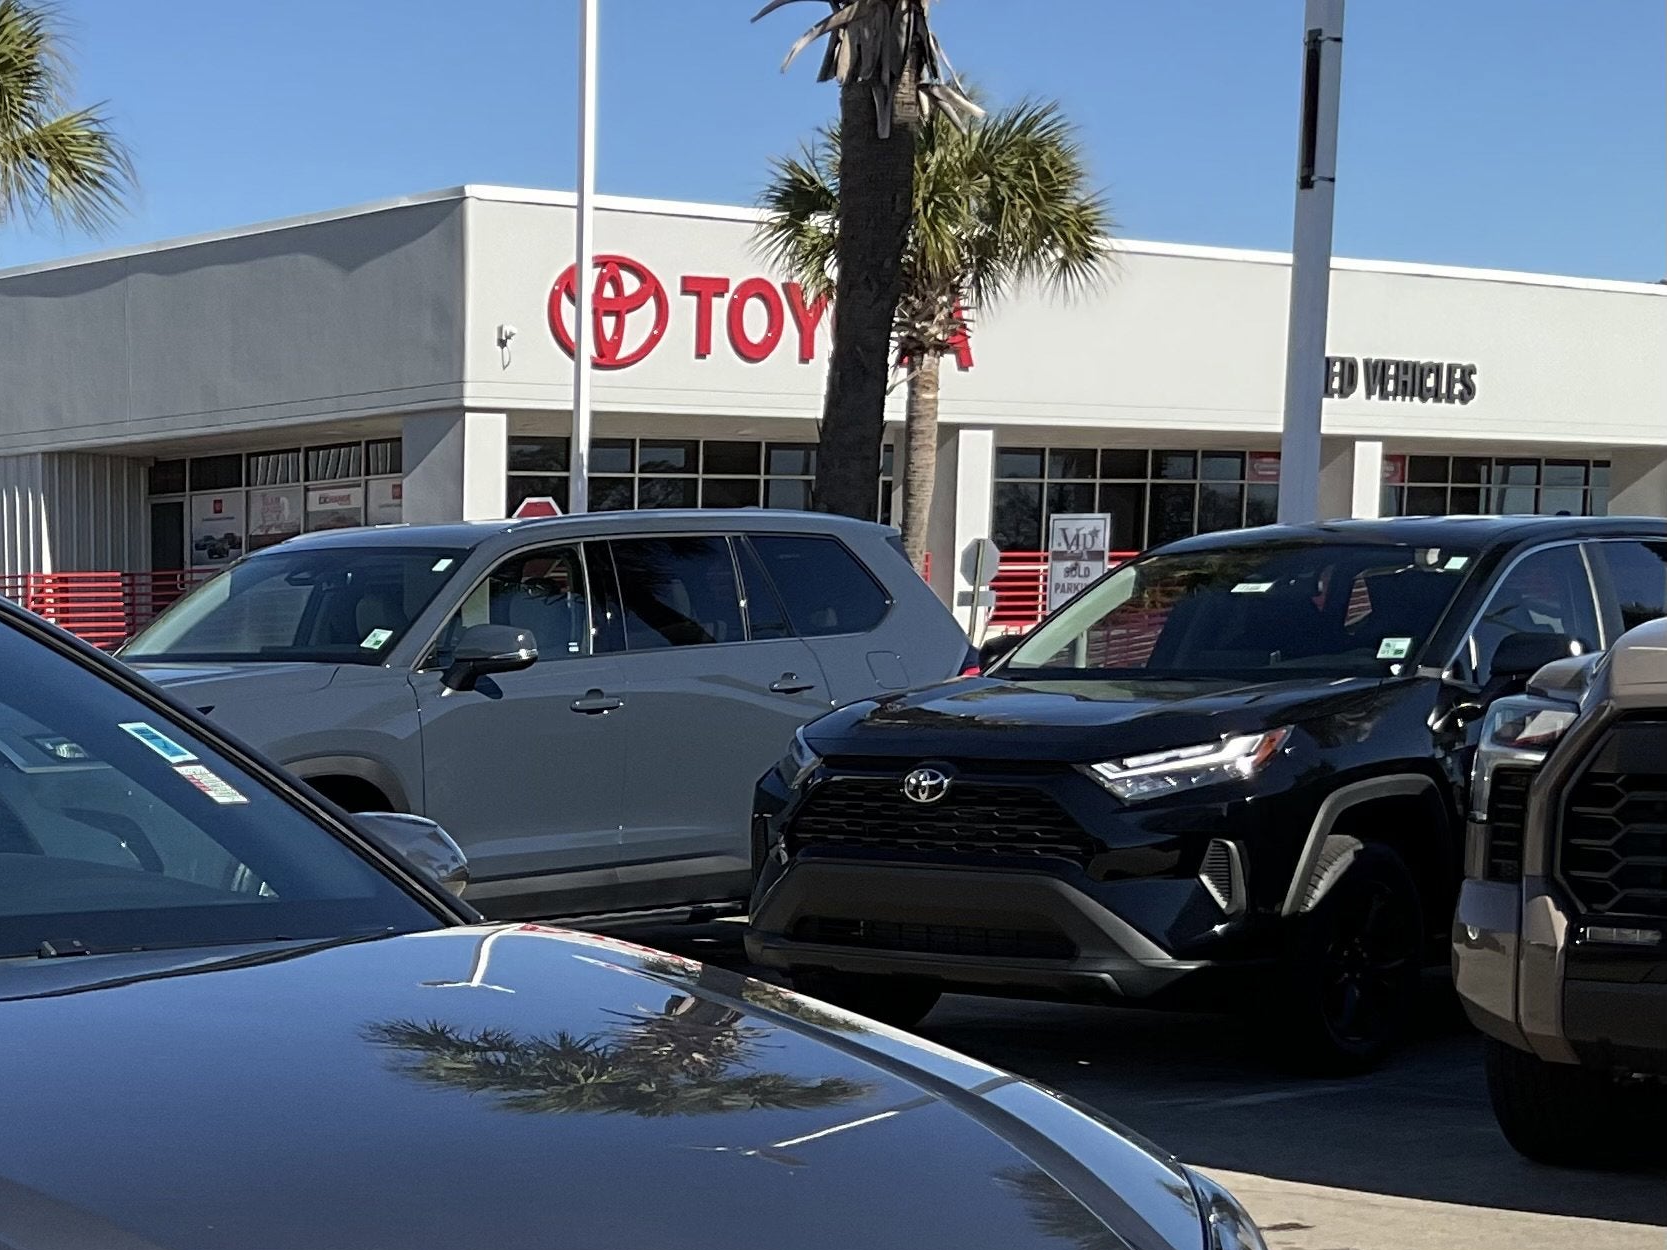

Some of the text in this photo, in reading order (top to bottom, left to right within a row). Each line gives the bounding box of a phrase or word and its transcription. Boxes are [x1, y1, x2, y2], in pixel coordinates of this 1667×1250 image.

[1323, 356, 1477, 405] ED VEHICLES
[1054, 582, 1089, 594] PARK
